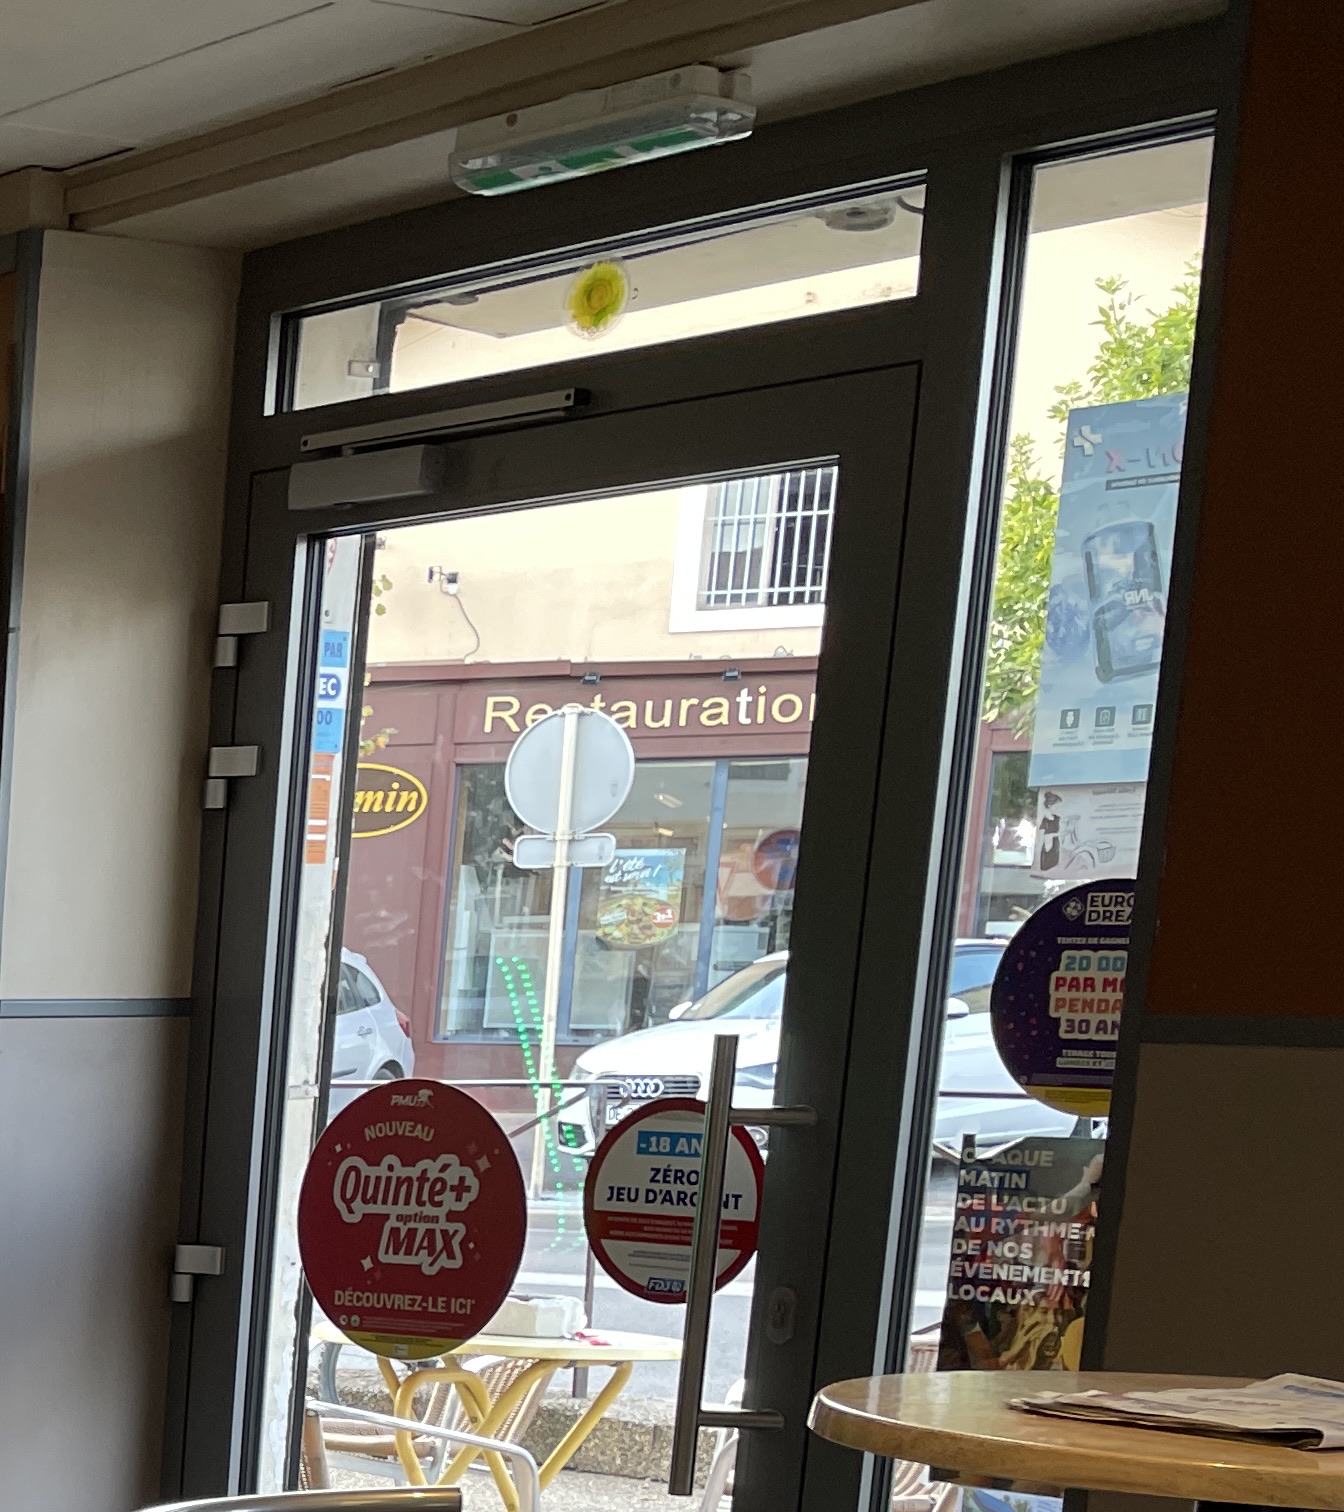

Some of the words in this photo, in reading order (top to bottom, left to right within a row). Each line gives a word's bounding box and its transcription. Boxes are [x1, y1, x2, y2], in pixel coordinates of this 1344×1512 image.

[483, 686, 816, 733] Retauratio
[1065, 956, 1090, 971] 20
[1054, 977, 1096, 992] PAR
[1054, 998, 1123, 1014] PENDA
[363, 1120, 435, 1143] NOUVEAU
[639, 1135, 671, 1153] -18
[962, 1148, 1054, 1168] CAQUE
[338, 1158, 473, 1210] Quinté+
[649, 1164, 700, 1186] ZÉRO
[959, 1169, 1027, 1189] MATIN
[606, 1186, 639, 1202] JEU
[957, 1193, 985, 1210] DE
[991, 1194, 1067, 1214] L'ACTU
[395, 1211, 440, 1225] option
[954, 1215, 986, 1233] AU
[991, 1217, 1082, 1240] RYTHME
[382, 1226, 463, 1268] MAX
[953, 1238, 982, 1255] DE
[988, 1240, 1033, 1259] NOS
[333, 1288, 448, 1312] DÉCOUVREZ-LE
[948, 1283, 1036, 1306] LOCAUX
